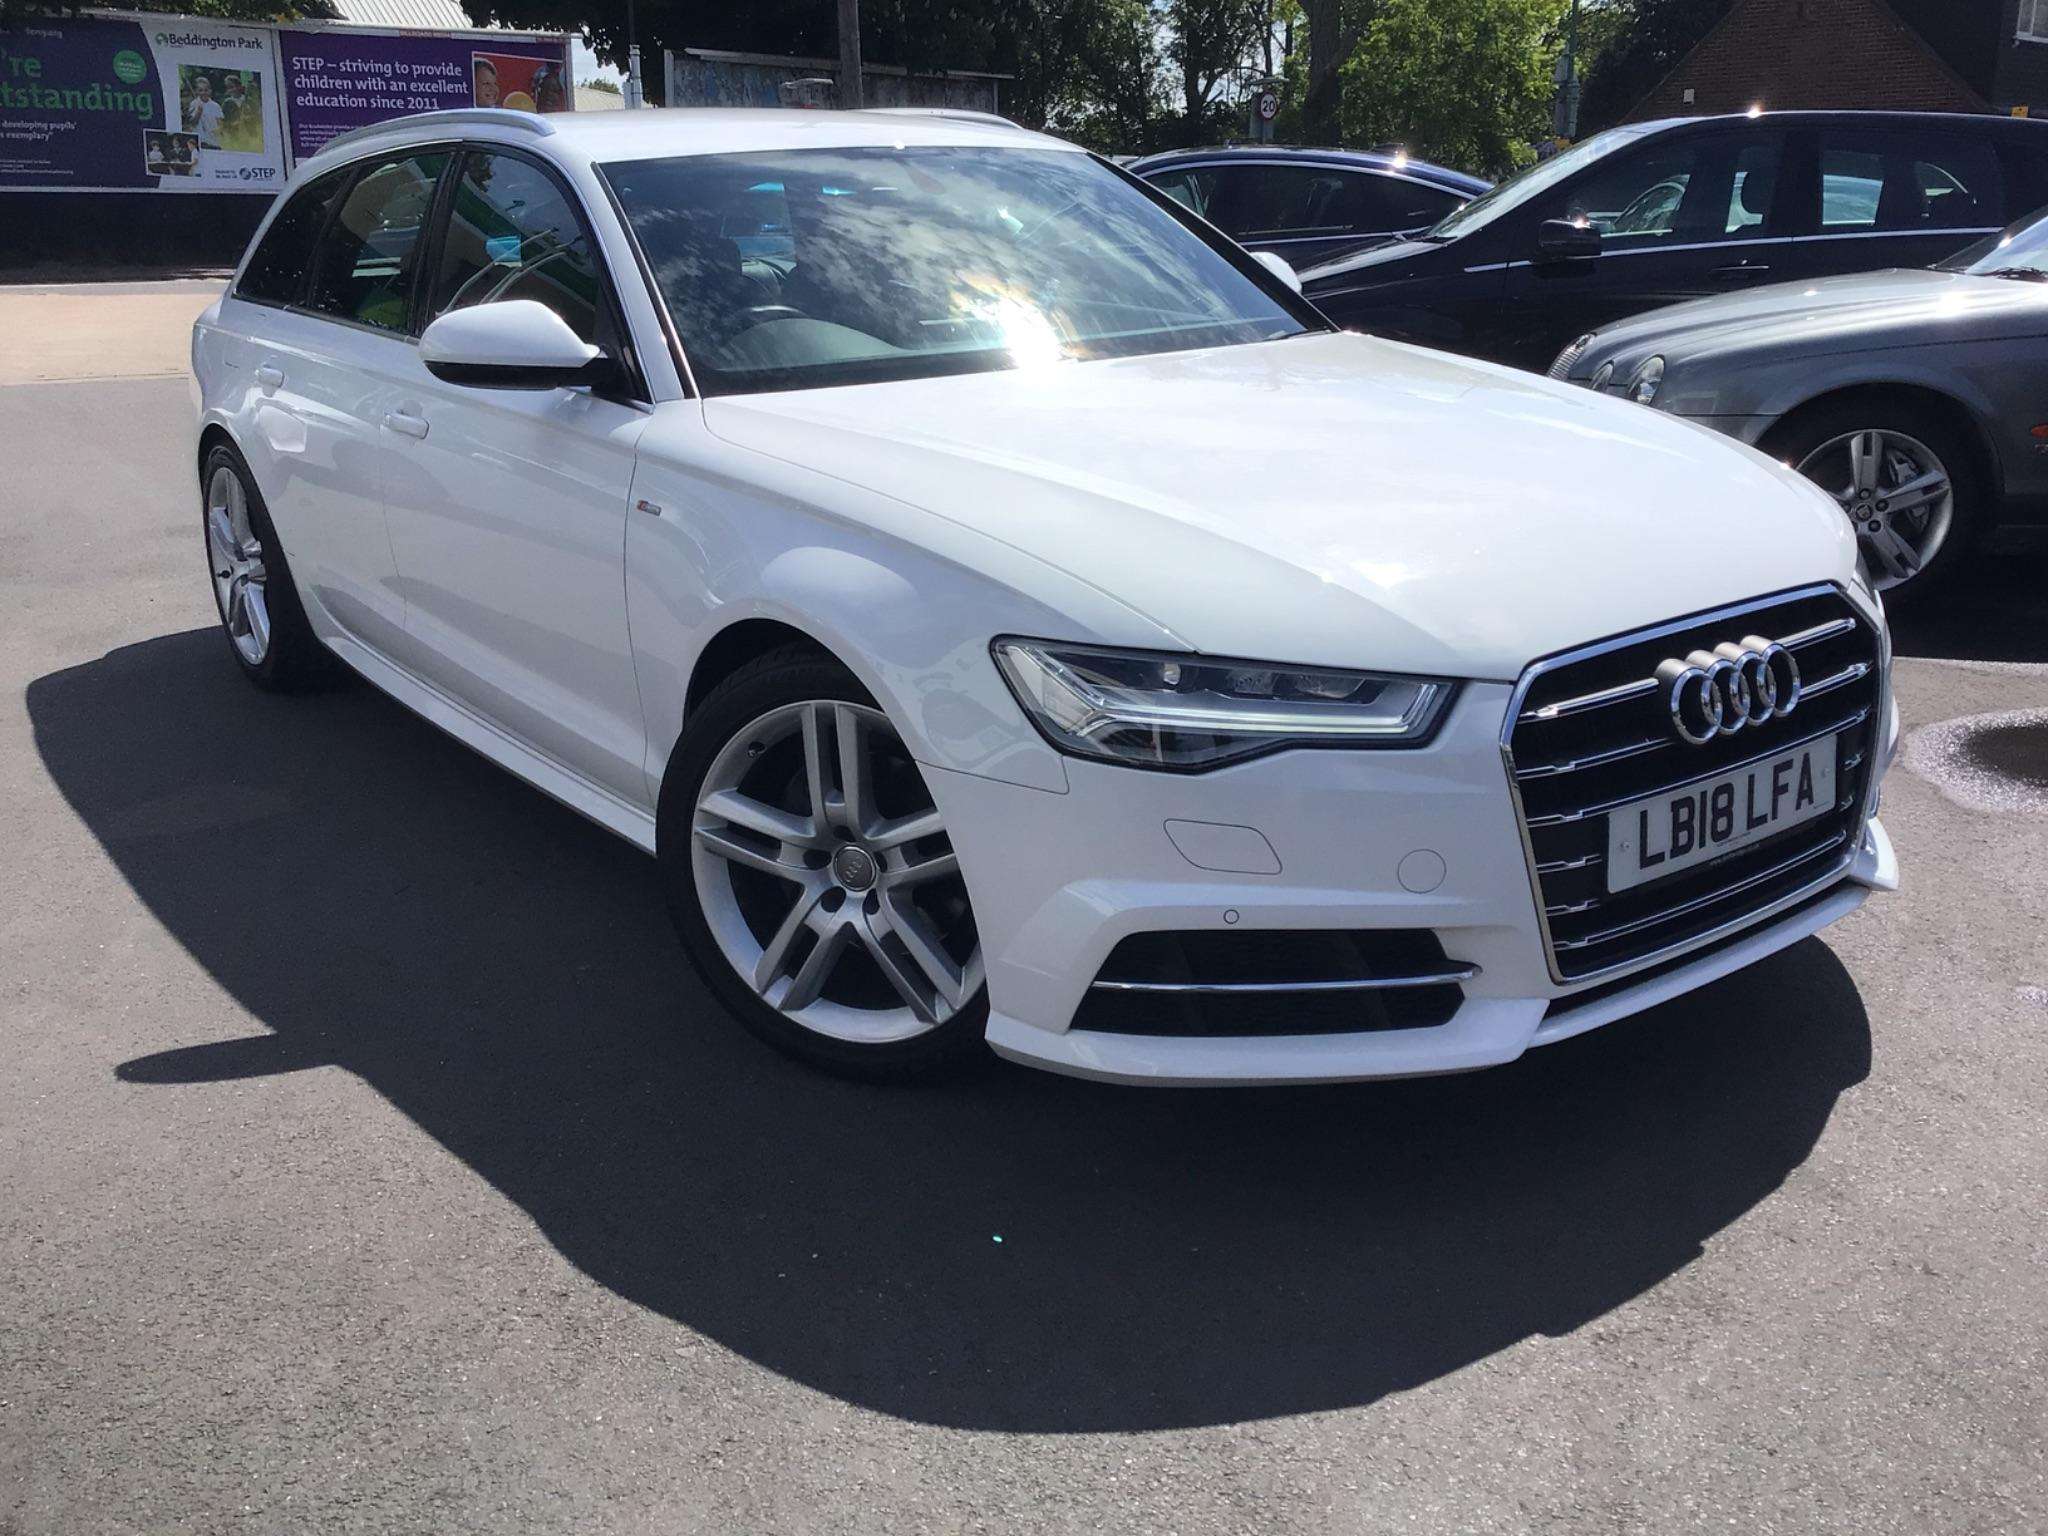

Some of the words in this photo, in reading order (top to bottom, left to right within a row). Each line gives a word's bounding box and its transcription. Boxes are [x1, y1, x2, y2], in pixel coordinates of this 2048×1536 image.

[168, 33, 236, 50] Beddington
[237, 37, 263, 50] Park
[292, 57, 325, 71] STEP
[339, 59, 393, 78] striving
[395, 61, 409, 75] to
[412, 63, 463, 78] provide
[294, 75, 352, 90] children
[355, 77, 387, 92] with
[389, 81, 407, 92] an
[409, 80, 469, 94] excellent
[296, 93, 368, 108] education
[370, 96, 405, 109] since
[407, 97, 440, 110] 2011
[1263, 100, 1275, 112] 20
[251, 167, 276, 179] STEP
[1639, 782, 1735, 870] LB18
[1747, 752, 1814, 830] LFA
